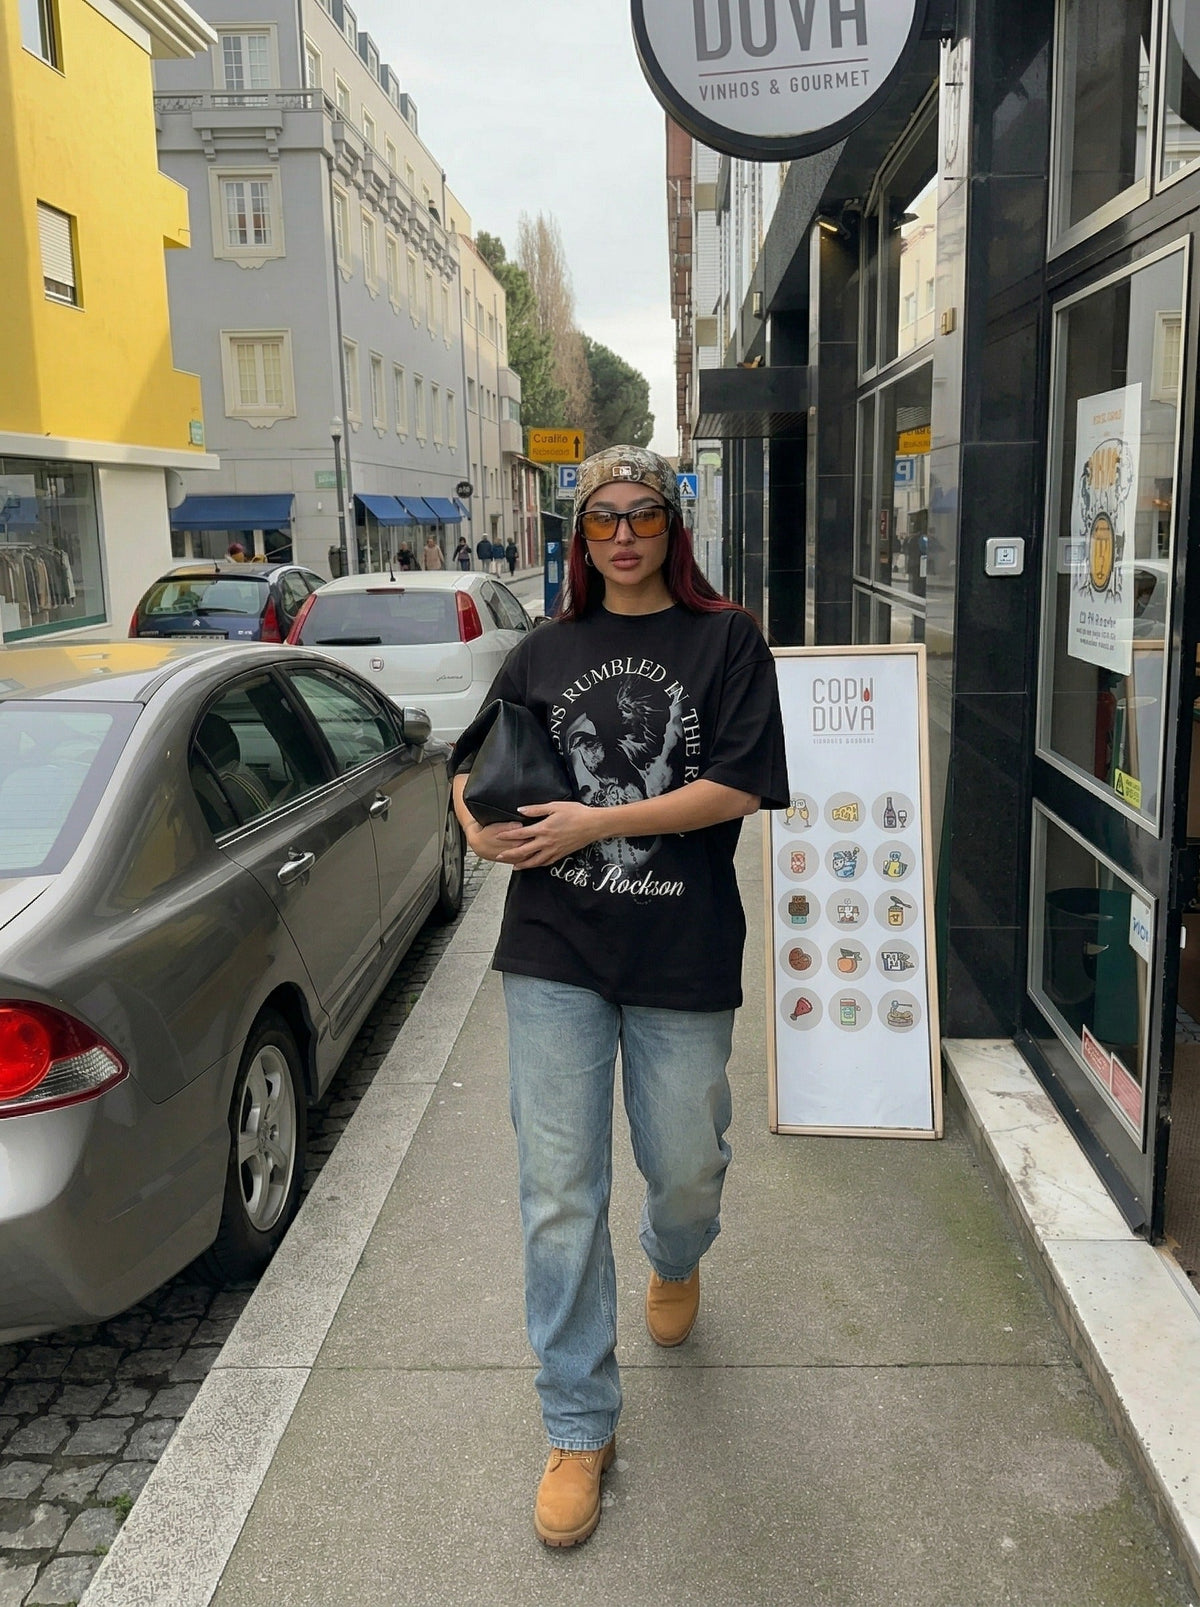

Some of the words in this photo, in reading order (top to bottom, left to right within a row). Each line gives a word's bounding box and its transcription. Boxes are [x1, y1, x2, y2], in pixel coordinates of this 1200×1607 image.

[699, 80, 760, 101] VINHOS
[769, 79, 781, 95] &
[790, 69, 870, 93] GOURMET
[562, 468, 577, 487] P
[561, 656, 667, 704] RUMBLED
[664, 680, 690, 704] IN
[680, 708, 701, 757] THE
[812, 705, 875, 731] DUVA
[684, 765, 699, 785] R
[592, 863, 686, 897] Rockson
